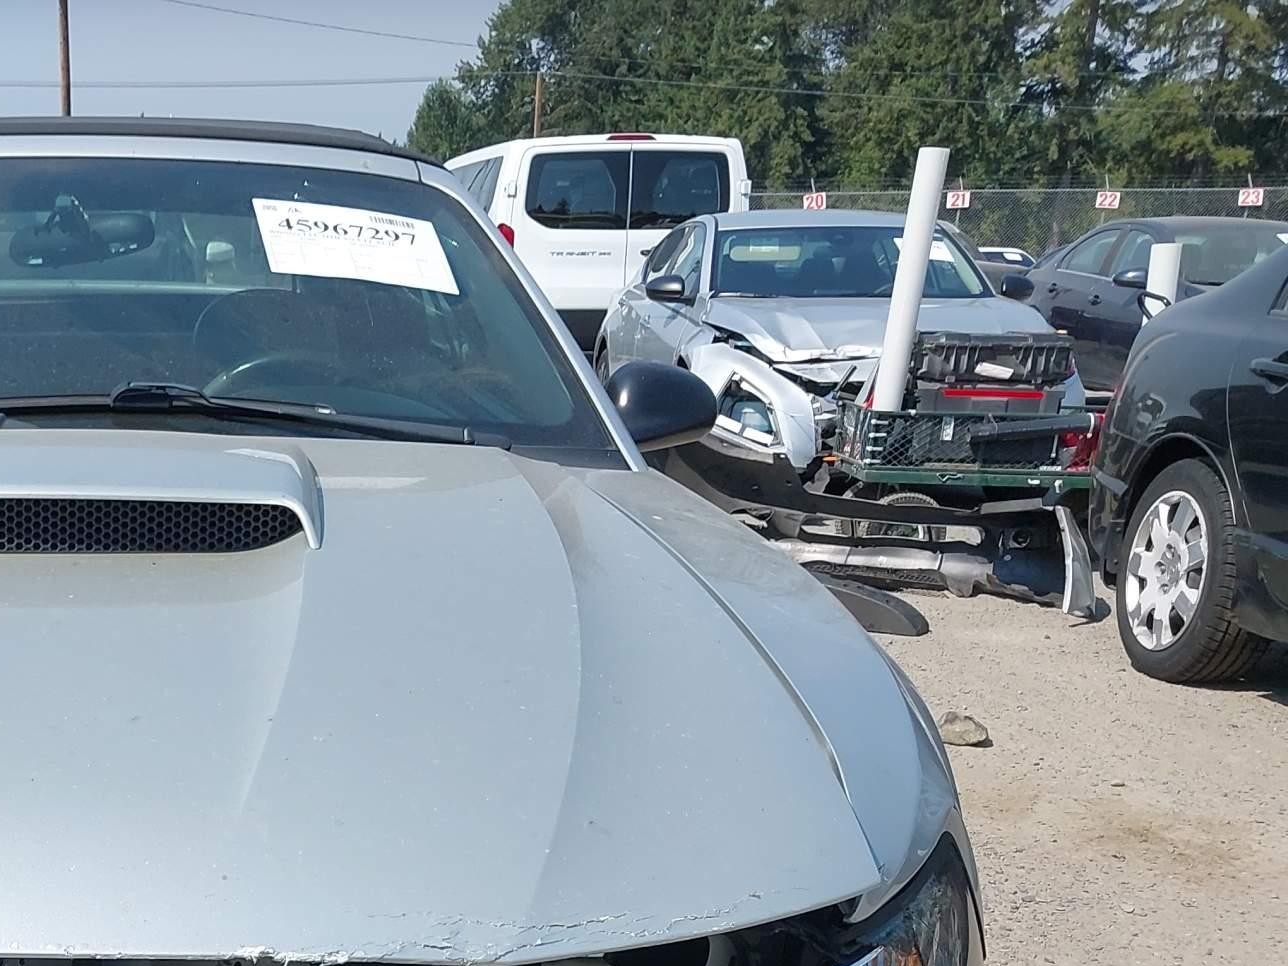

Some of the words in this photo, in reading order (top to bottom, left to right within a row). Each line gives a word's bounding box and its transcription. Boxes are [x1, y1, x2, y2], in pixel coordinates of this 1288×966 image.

[806, 194, 824, 209] 20
[951, 193, 966, 207] 21
[1098, 193, 1118, 207] 22
[1241, 190, 1261, 205] 23
[278, 217, 416, 246] 45967297
